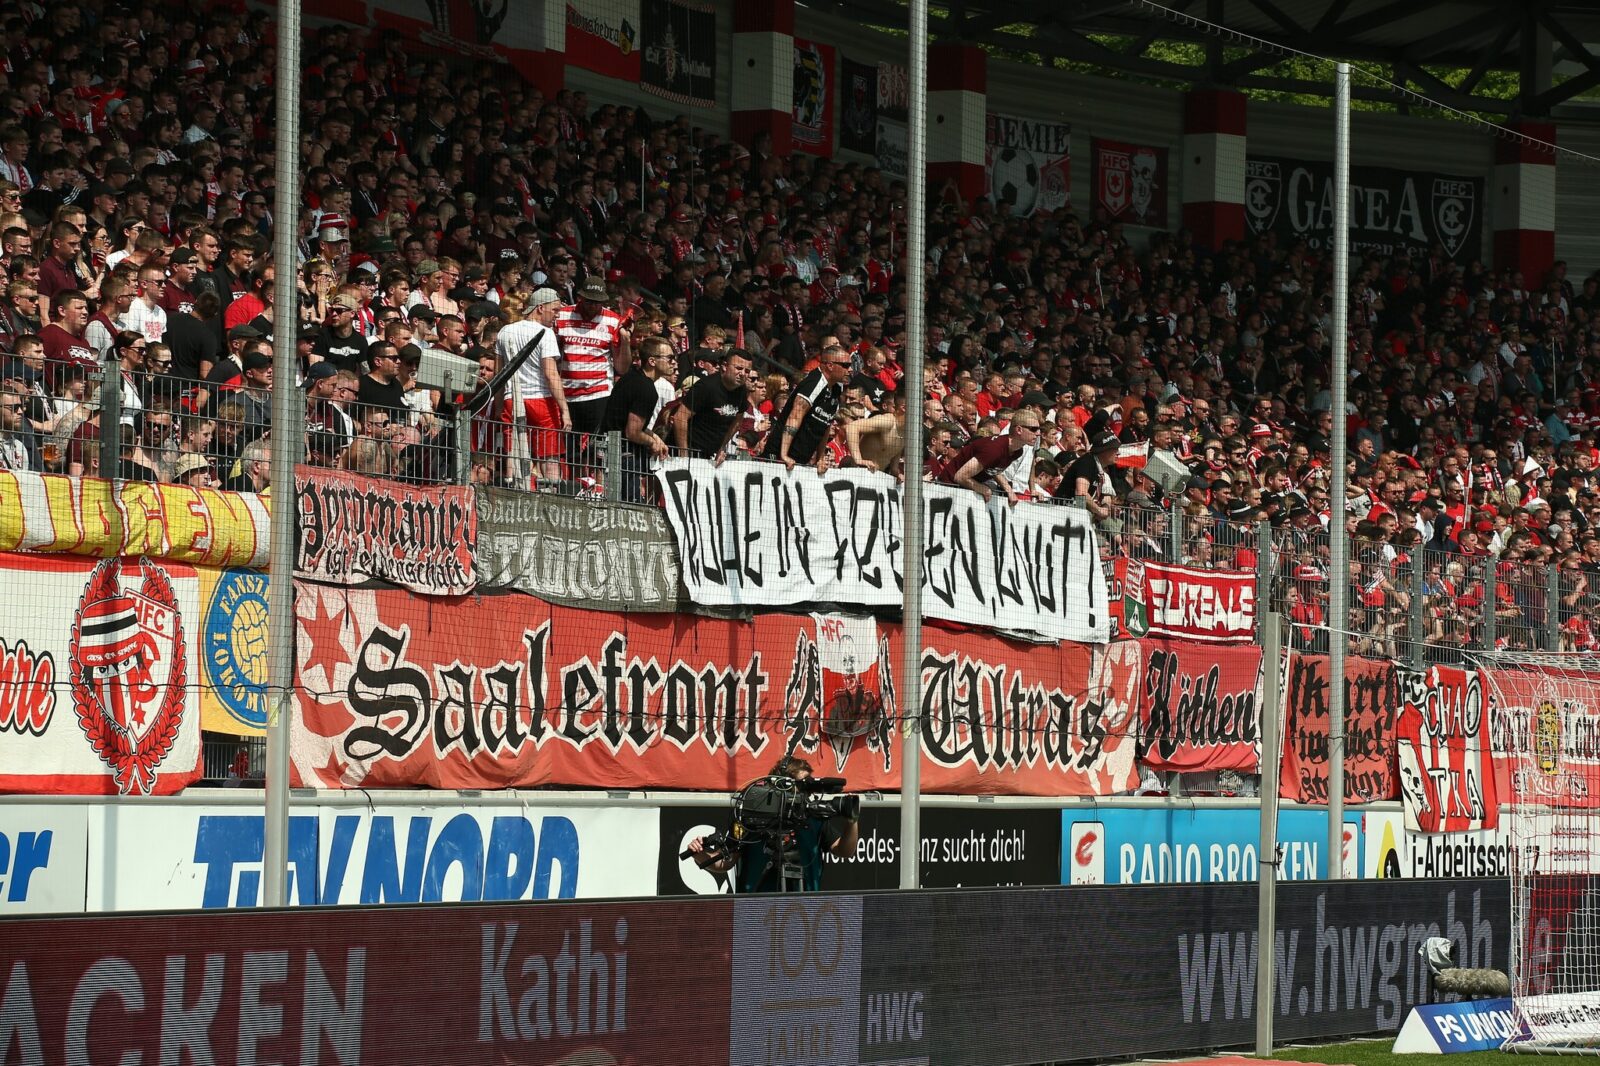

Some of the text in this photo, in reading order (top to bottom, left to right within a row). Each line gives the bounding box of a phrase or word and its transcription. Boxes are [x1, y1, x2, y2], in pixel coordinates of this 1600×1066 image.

[1102, 154, 1130, 170] HFC
[1440, 181, 1467, 195] HFC
[770, 477, 815, 585] IN
[219, 574, 270, 616] FANSZ
[344, 626, 767, 761] Saalefront
[921, 654, 1107, 770] Ultras
[1145, 648, 1257, 760] Köthen
[358, 813, 580, 905] NORD
[942, 829, 987, 863] sucht
[989, 828, 1026, 862] dich!
[1119, 841, 1318, 884] RADIO BROKEN
[763, 902, 845, 980] 100
[477, 917, 629, 1044] Kathi
[865, 991, 924, 1046] HWG
[1433, 1014, 1467, 1044] PS
